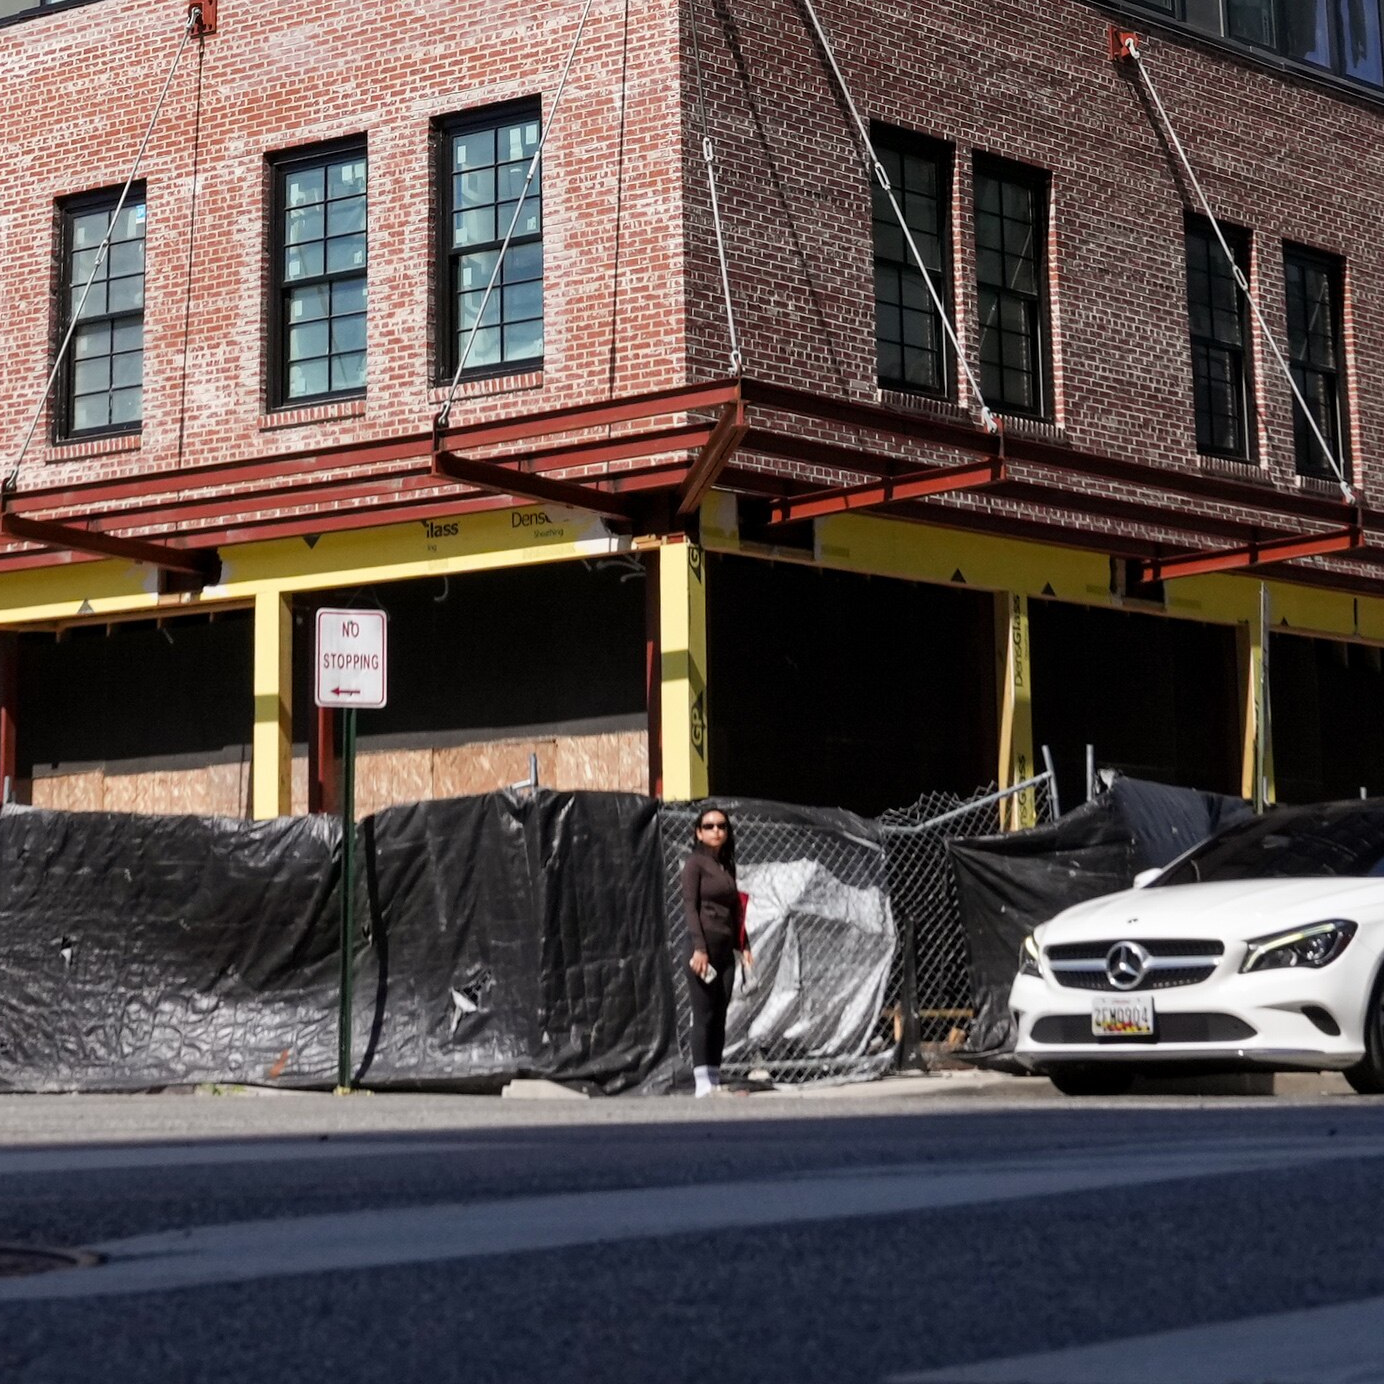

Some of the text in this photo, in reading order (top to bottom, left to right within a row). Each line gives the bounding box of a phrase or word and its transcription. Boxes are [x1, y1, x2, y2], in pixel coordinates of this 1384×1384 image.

[342, 621, 360, 638] NO
[323, 652, 379, 670] STOPPING
[690, 712, 703, 747] GP
